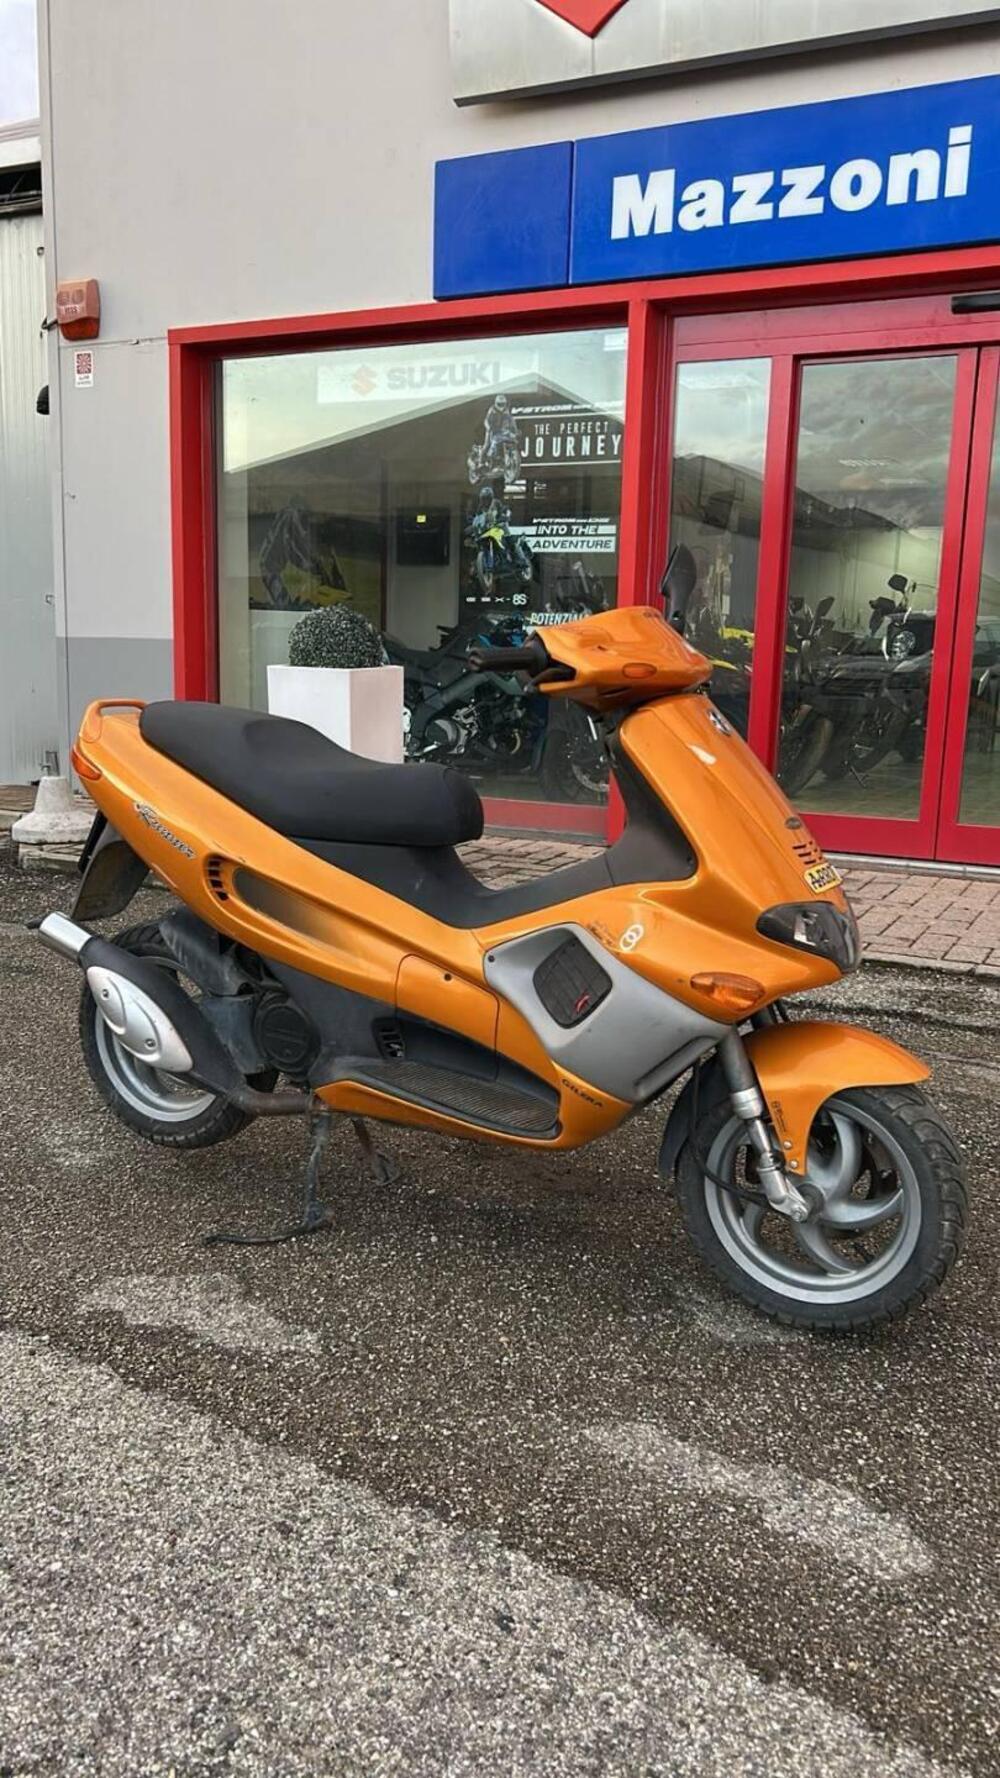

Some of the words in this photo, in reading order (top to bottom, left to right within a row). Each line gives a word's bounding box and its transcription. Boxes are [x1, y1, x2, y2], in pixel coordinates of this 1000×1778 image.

[610, 125, 973, 240] Mazzoni
[387, 362, 501, 391] SUZUKI
[534, 423, 551, 435] THE
[560, 421, 609, 434] PERFECT
[520, 434, 622, 458] JOURNEY
[537, 525, 568, 535] INTO
[571, 524, 599, 535] THE
[532, 539, 613, 549] ADVENTURE
